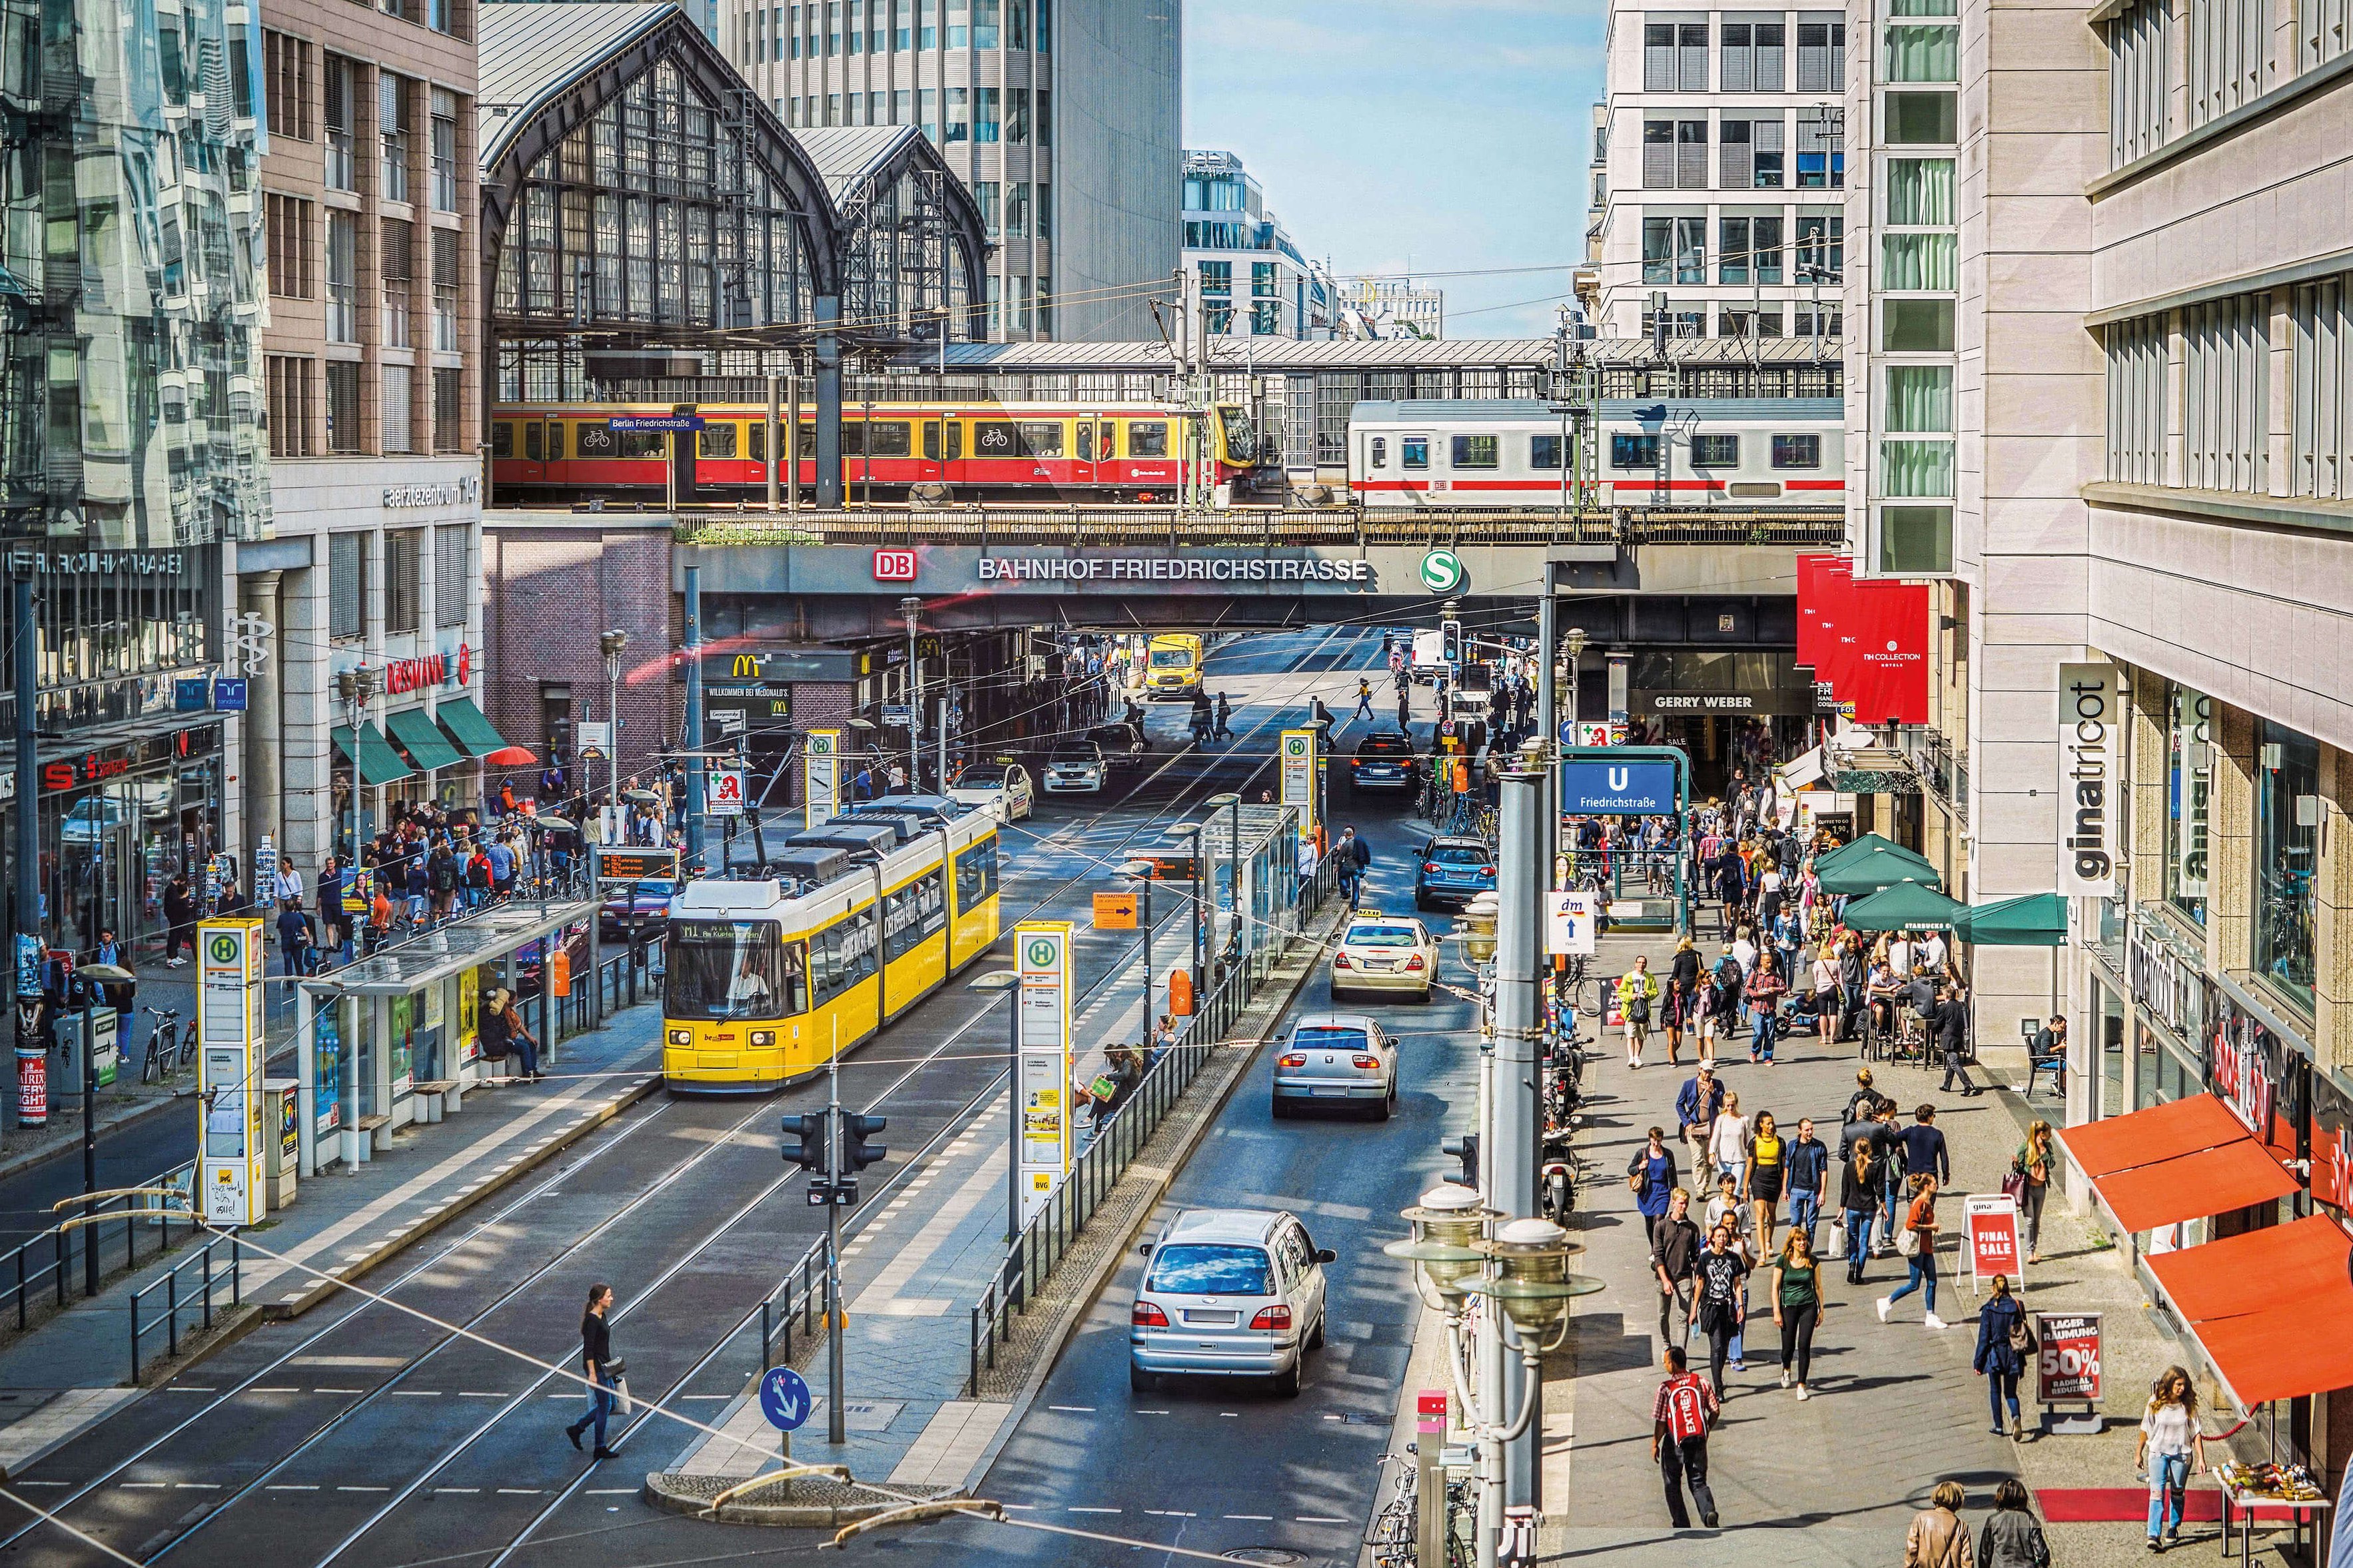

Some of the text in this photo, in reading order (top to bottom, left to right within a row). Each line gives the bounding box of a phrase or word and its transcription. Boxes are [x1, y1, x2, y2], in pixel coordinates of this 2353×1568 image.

[384, 485, 460, 508] aerztezentrum
[879, 554, 911, 576] DB
[979, 559, 1368, 580] BAHNHOF FRIEDRICHSTRASSE
[1426, 555, 1455, 586] S
[387, 653, 444, 695] ROSSMANN
[709, 688, 744, 697] WILLKOMMEN
[1655, 697, 1752, 707] GERRY WEBER
[1608, 767, 1628, 791] U
[2067, 681, 2111, 879] ginatricot
[1580, 797, 1655, 808] Friedrichstraße
[1832, 825, 1846, 835] 1,90
[1561, 899, 1583, 911] dm
[684, 926, 698, 937] M1
[2214, 1022, 2240, 1100] Shoe
[18, 1072, 45, 1084] ATRIX
[19, 1084, 45, 1094] VERY
[19, 1094, 45, 1105] IGHT
[1979, 1231, 2011, 1242] FINAL
[1979, 1243, 2011, 1255] SALE
[2051, 1318, 2085, 1330] LAGER
[2042, 1349, 2100, 1375] 50%
[2053, 1377, 2090, 1387] RADIKAL
[2052, 1383, 2094, 1395] REDUZIERT
[1679, 1389, 1696, 1434] EXTREM
